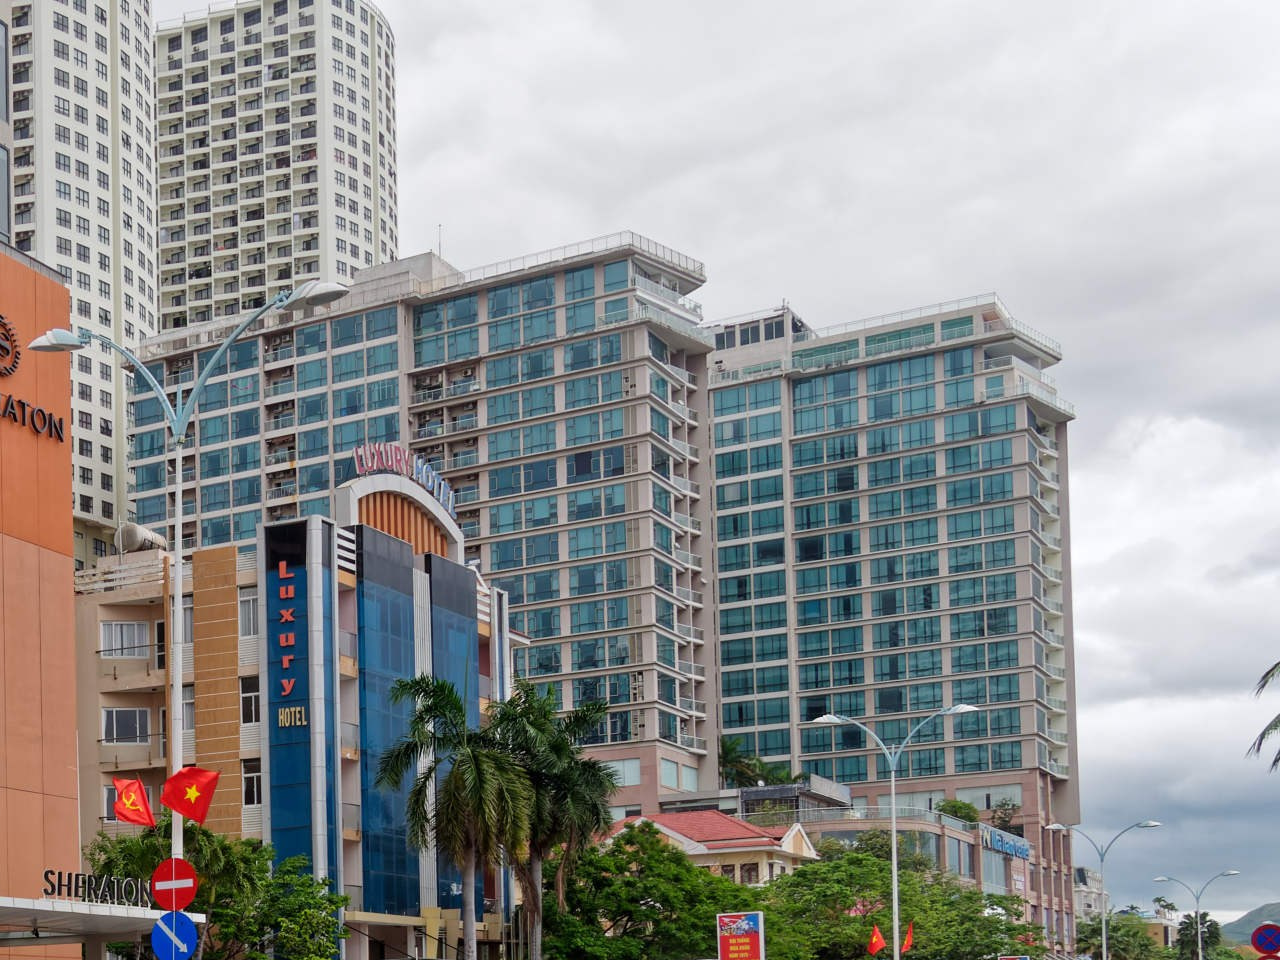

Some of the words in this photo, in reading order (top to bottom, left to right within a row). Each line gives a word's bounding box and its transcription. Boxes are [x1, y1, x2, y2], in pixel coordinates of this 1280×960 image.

[353, 442, 412, 476] LUXURY
[413, 453, 457, 520] HOTEL
[278, 560, 296, 696] Luxury
[278, 706, 308, 728] HOTEL
[43, 869, 153, 906] SHERATON
